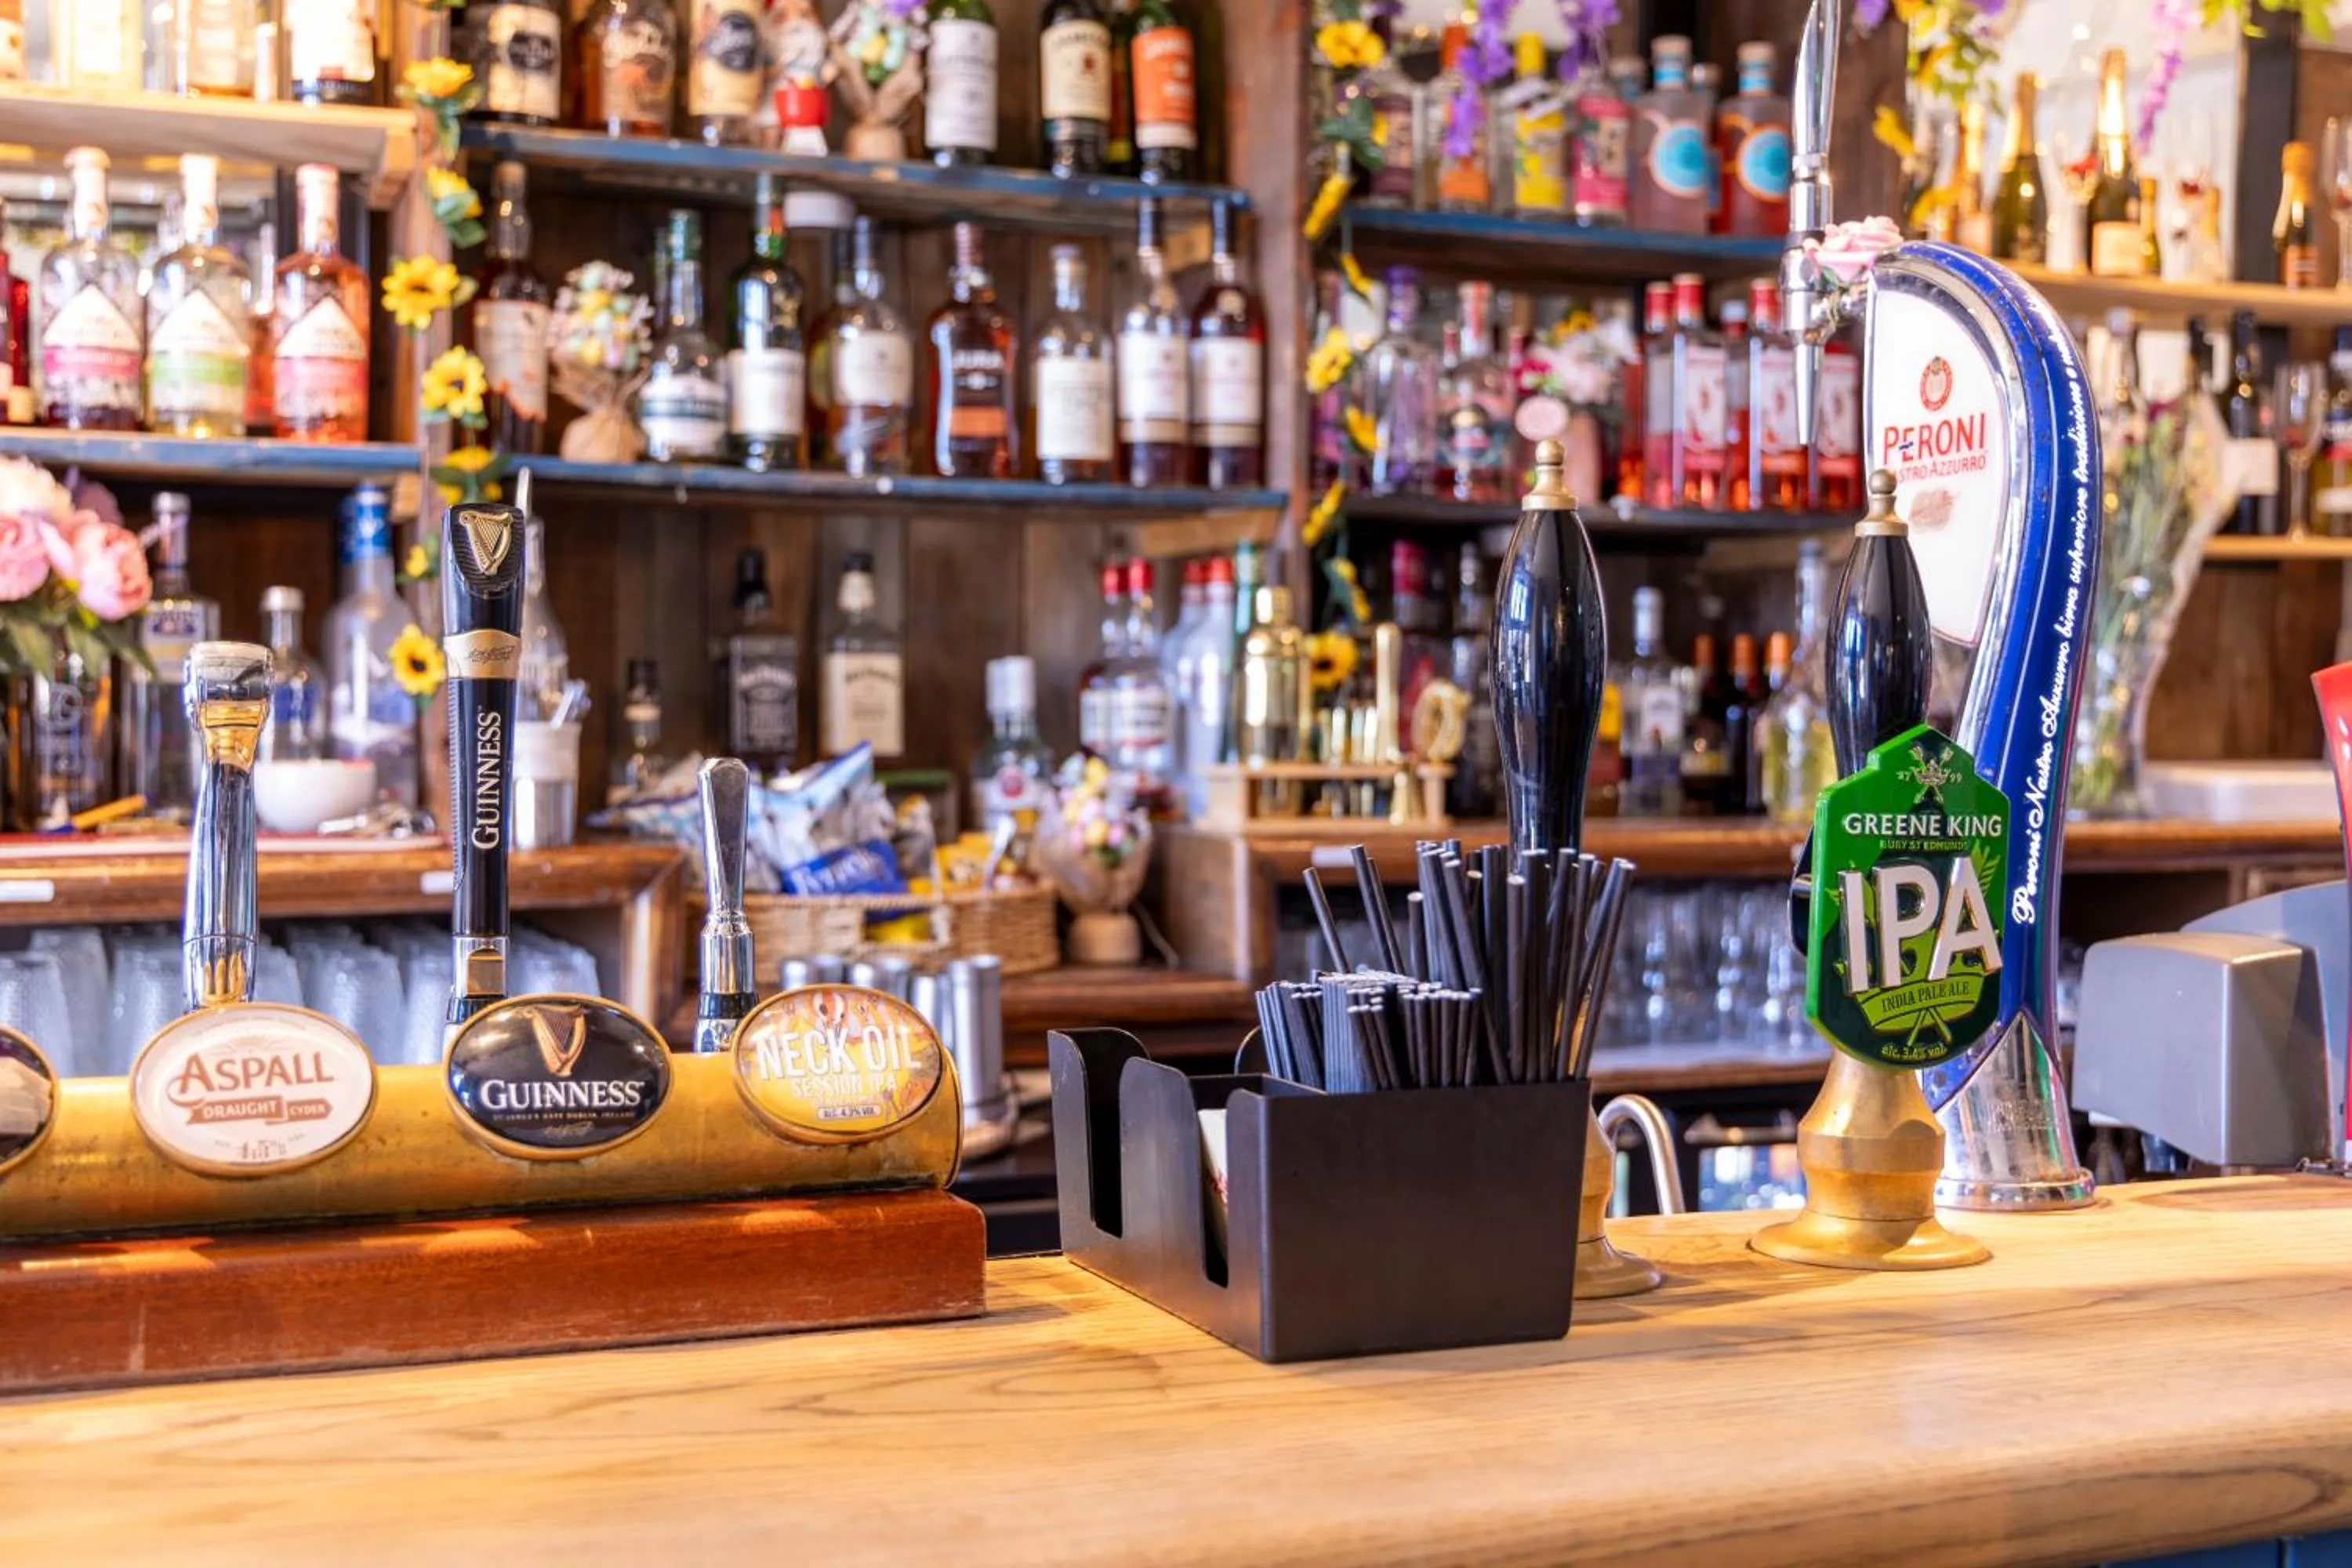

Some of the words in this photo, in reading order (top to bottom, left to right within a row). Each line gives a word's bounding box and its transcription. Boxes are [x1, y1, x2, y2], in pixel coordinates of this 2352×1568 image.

[1884, 413, 1985, 464] PERONI
[1929, 455, 1986, 476] AZZURRO
[471, 710, 502, 849] GUINNESS
[2024, 741, 2053, 828] Nastro
[1844, 814, 1941, 836] GREENE
[1947, 815, 2002, 837] KING
[1879, 840, 1907, 849] BURY
[2012, 829, 2042, 924] Peroni
[1838, 857, 2003, 996] IPA
[1882, 991, 1915, 1012] INDIA
[1918, 985, 1947, 1002] PALE
[1949, 981, 1970, 996] ALE
[170, 1051, 334, 1098] ASPALL
[756, 1028, 859, 1080] NECK
[863, 1024, 922, 1073] OIL
[203, 1101, 277, 1119] DRAUGHT
[290, 1104, 326, 1116] CYDER
[480, 1080, 643, 1109] GUINNESS
